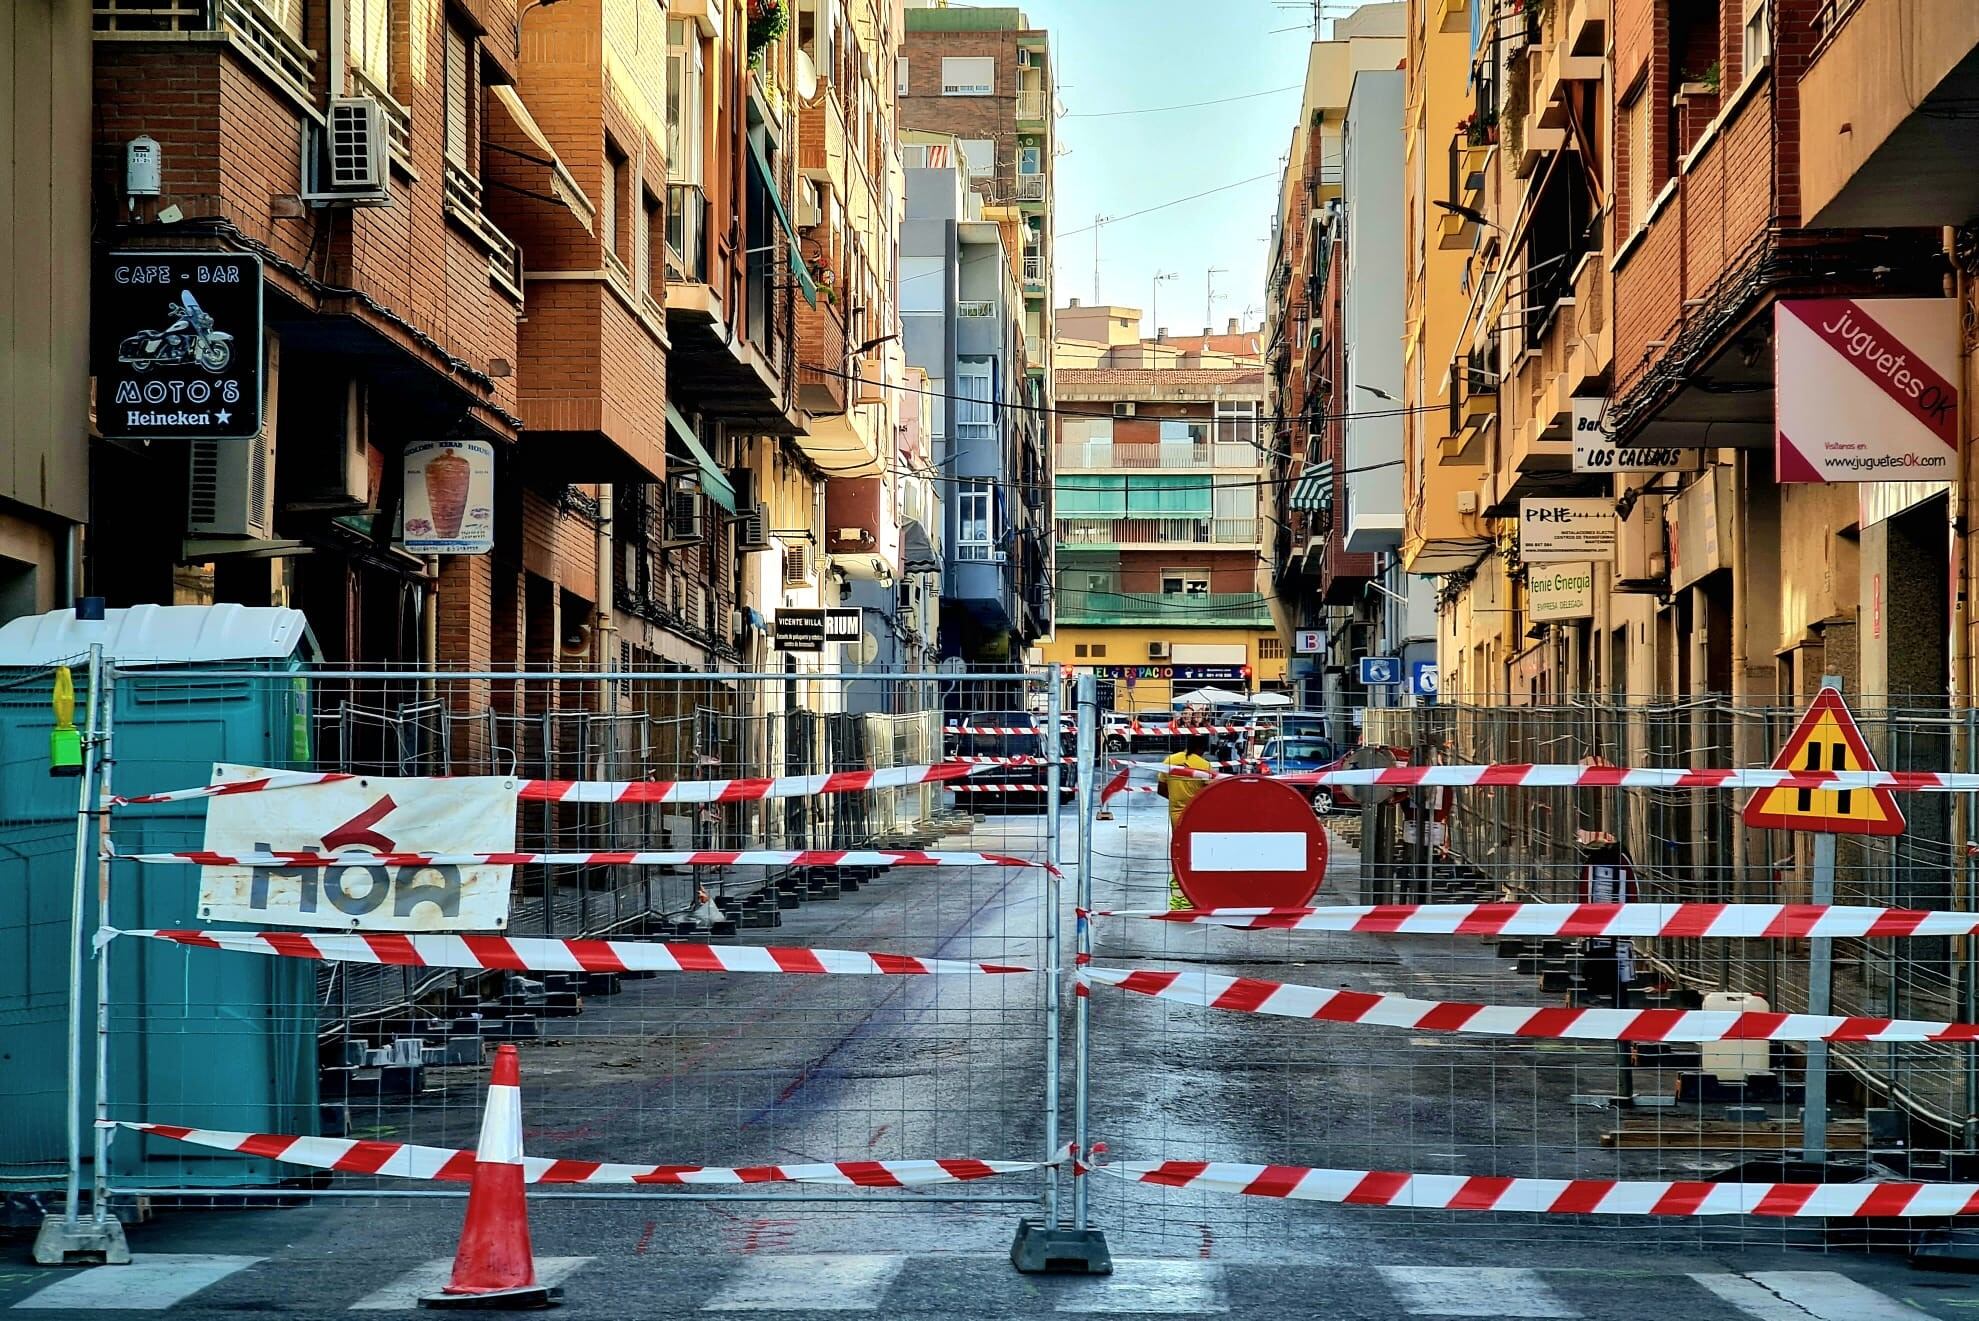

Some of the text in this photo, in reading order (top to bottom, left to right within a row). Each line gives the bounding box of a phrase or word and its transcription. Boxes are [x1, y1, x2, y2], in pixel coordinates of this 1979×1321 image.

[115, 266, 170, 283] CAFE
[197, 266, 240, 283] BAR
[127, 410, 210, 426] Heineken
[1577, 417, 1600, 431] Bar
[1531, 576, 1552, 592] fenie
[779, 618, 803, 626] VICENTE
